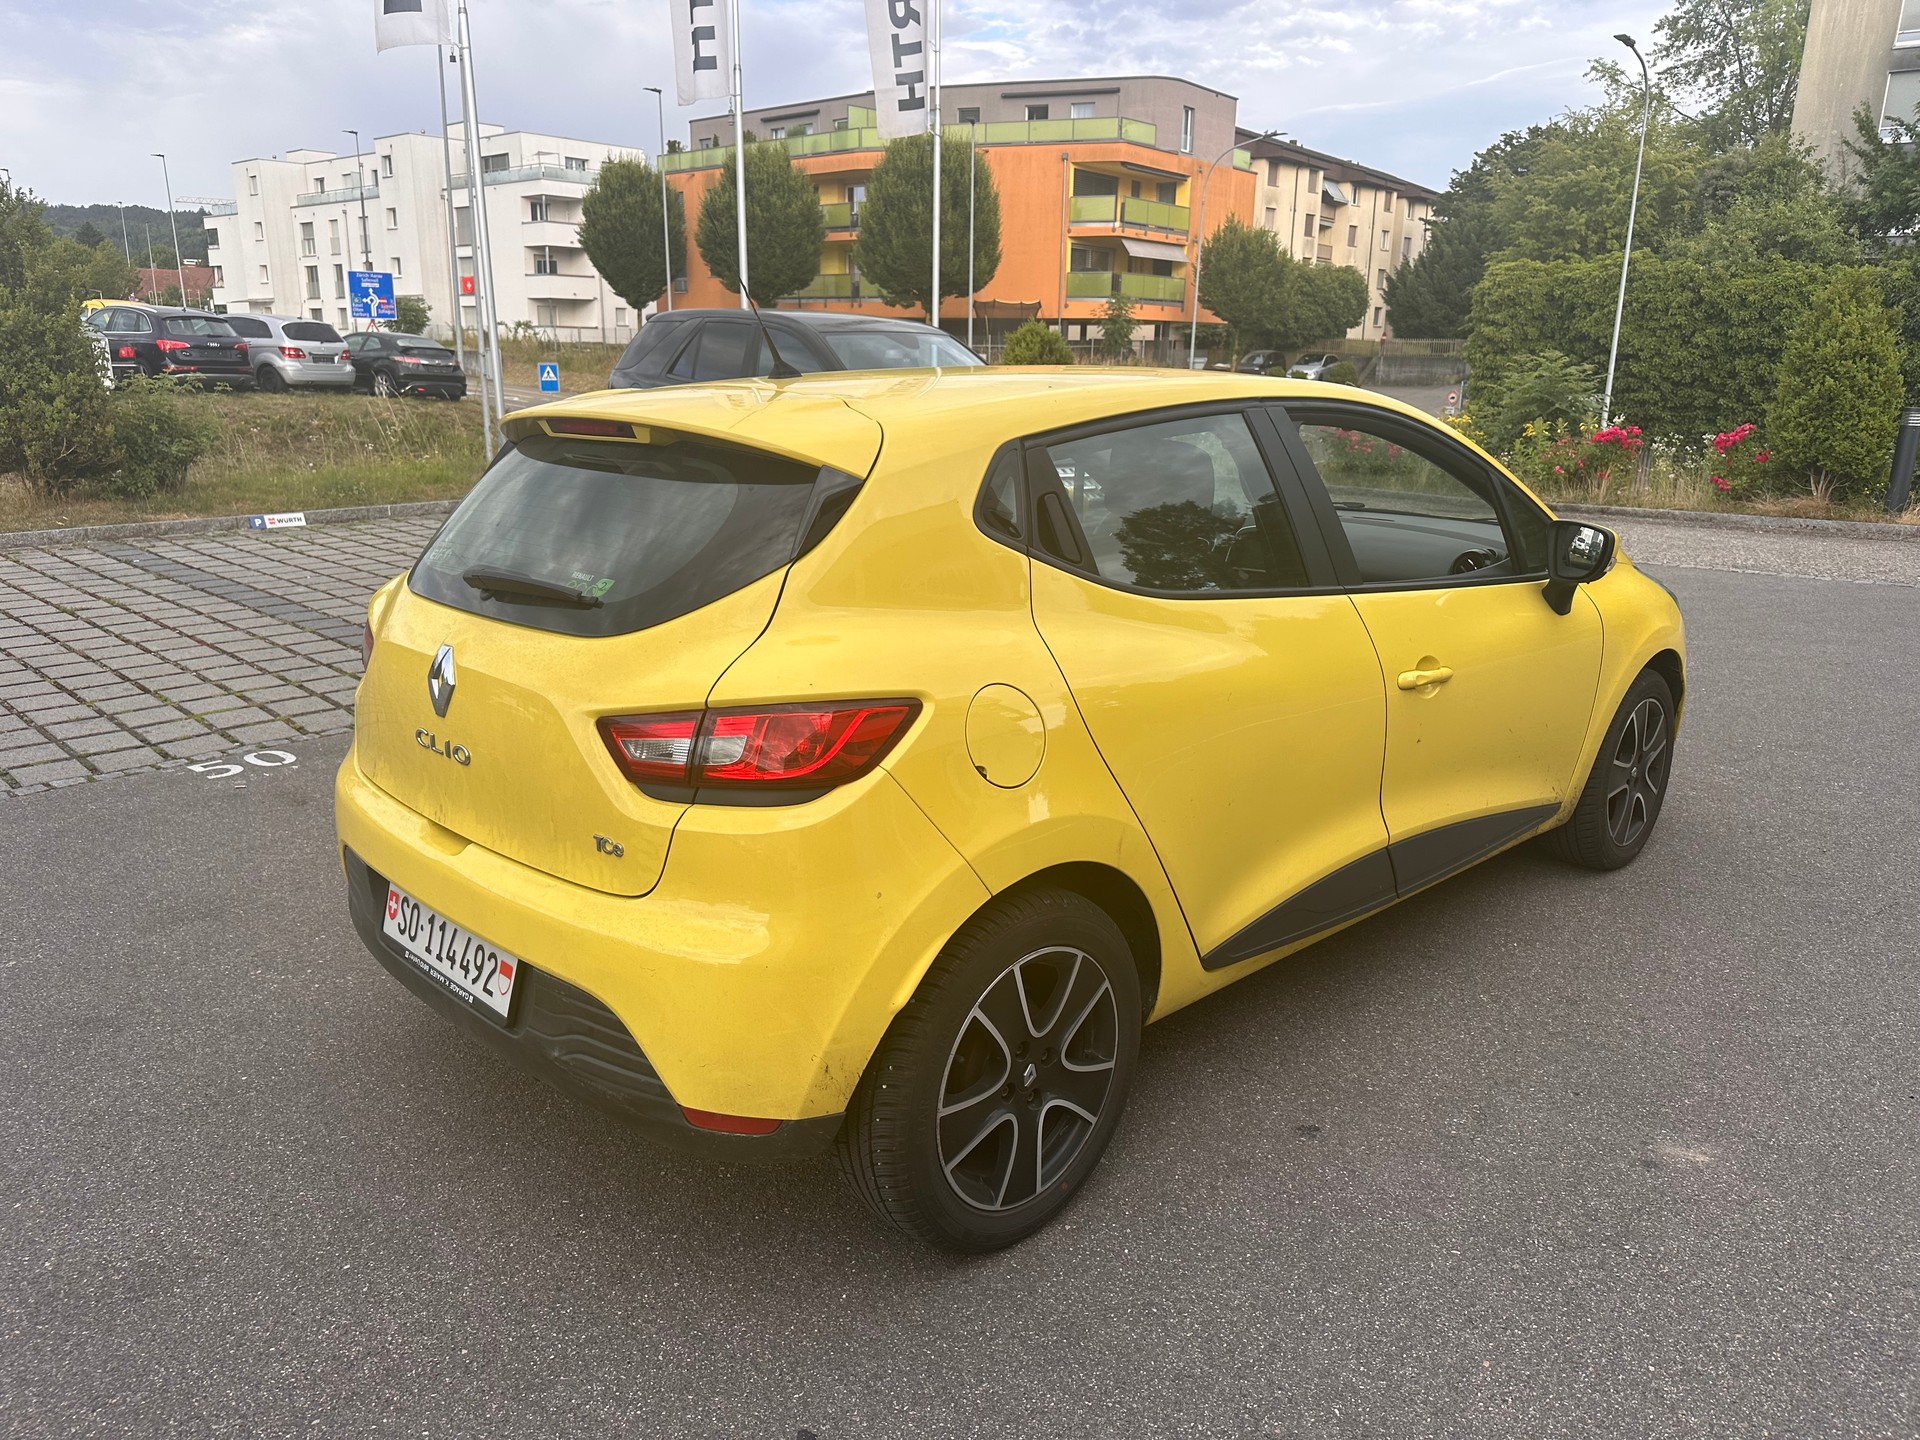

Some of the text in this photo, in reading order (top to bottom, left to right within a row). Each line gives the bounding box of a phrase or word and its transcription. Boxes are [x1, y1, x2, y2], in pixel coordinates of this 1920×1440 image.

[571, 571, 595, 581] RENAULT
[415, 728, 471, 766] CLIO
[186, 750, 298, 779] 50
[593, 833, 625, 858] TCe
